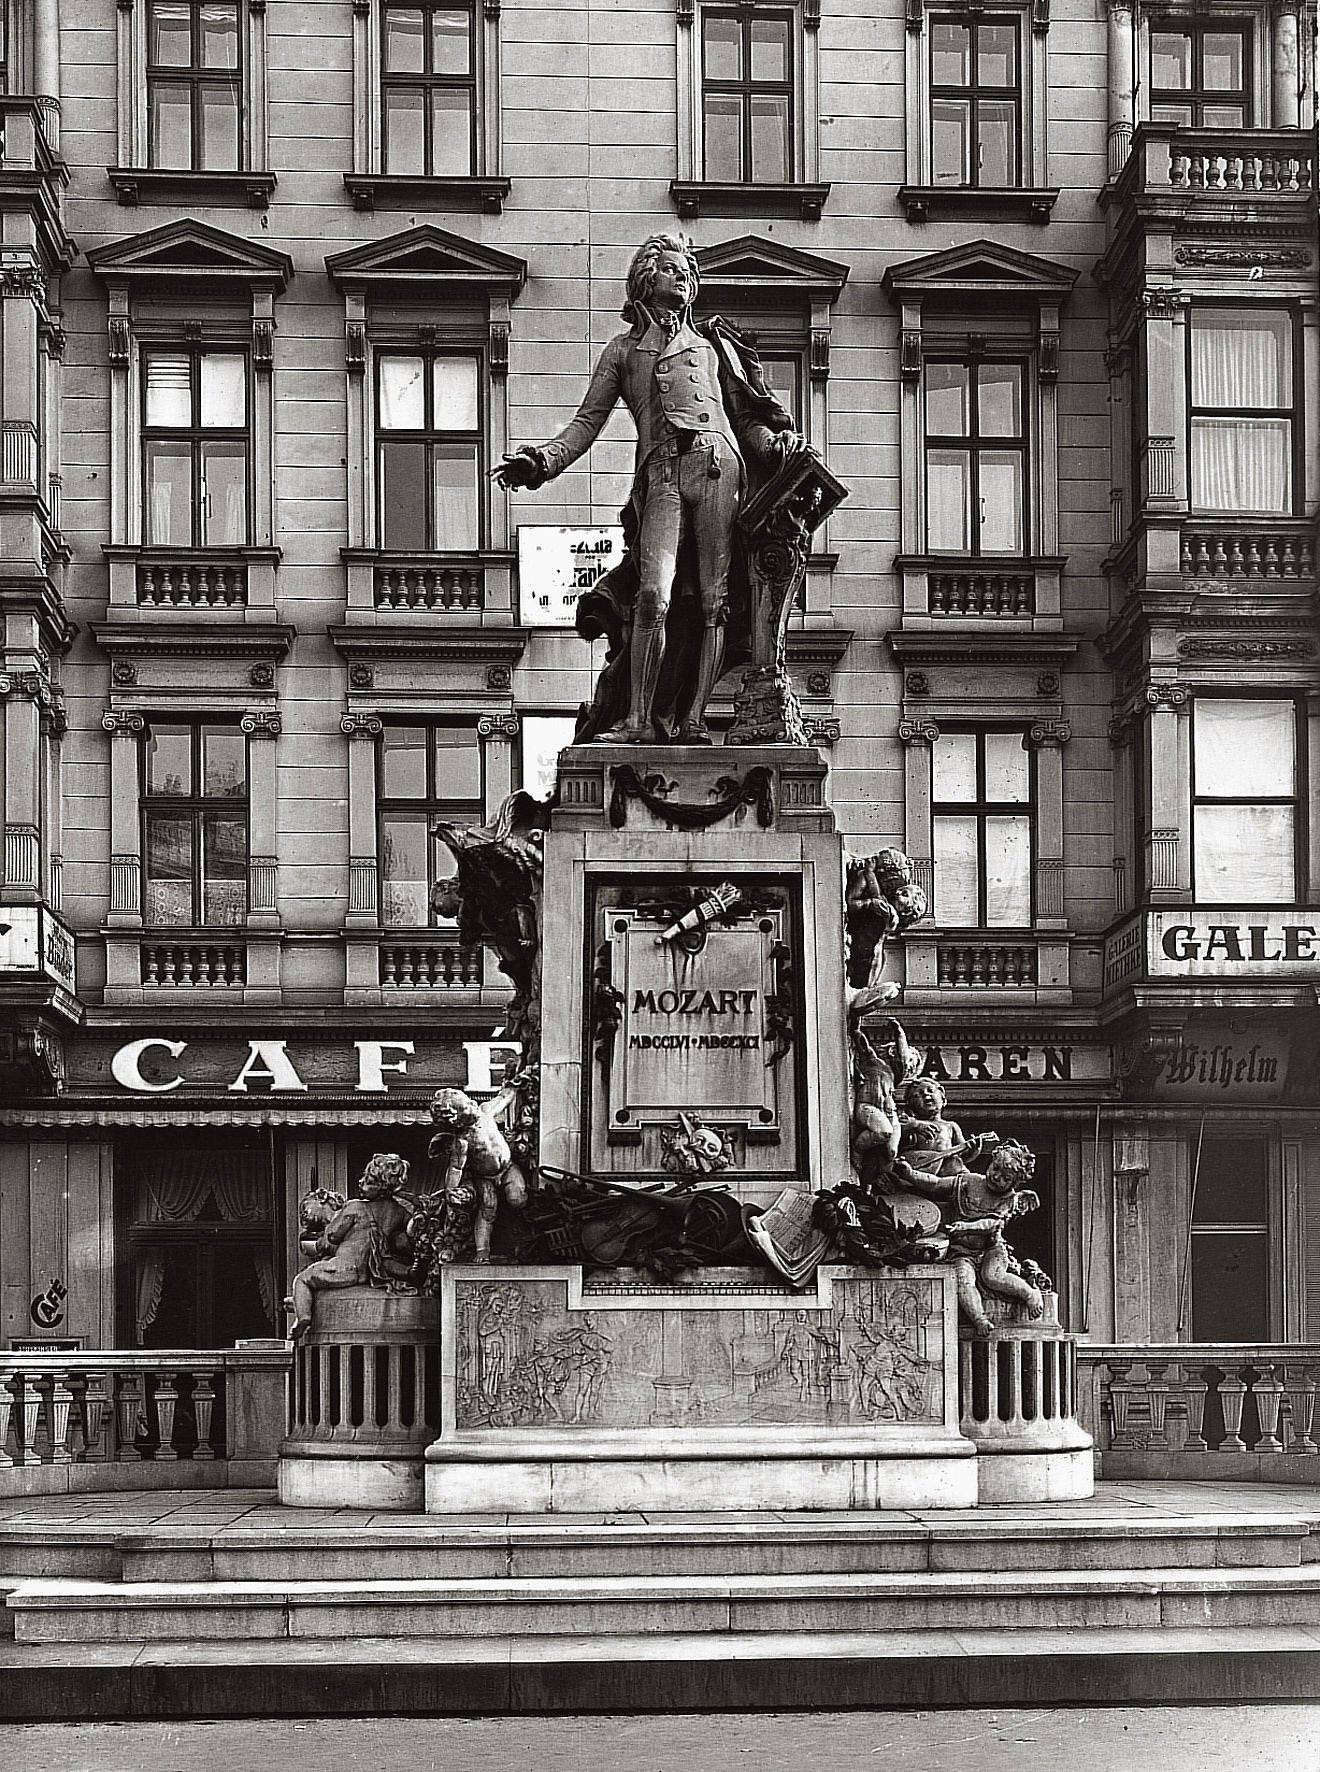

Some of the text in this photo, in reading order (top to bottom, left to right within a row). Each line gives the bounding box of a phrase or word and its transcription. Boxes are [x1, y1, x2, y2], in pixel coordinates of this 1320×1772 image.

[631, 988, 758, 1015] MOZART
[111, 1027, 523, 1093] CAFÉ
[1166, 1044, 1278, 1089] Wilhelm
